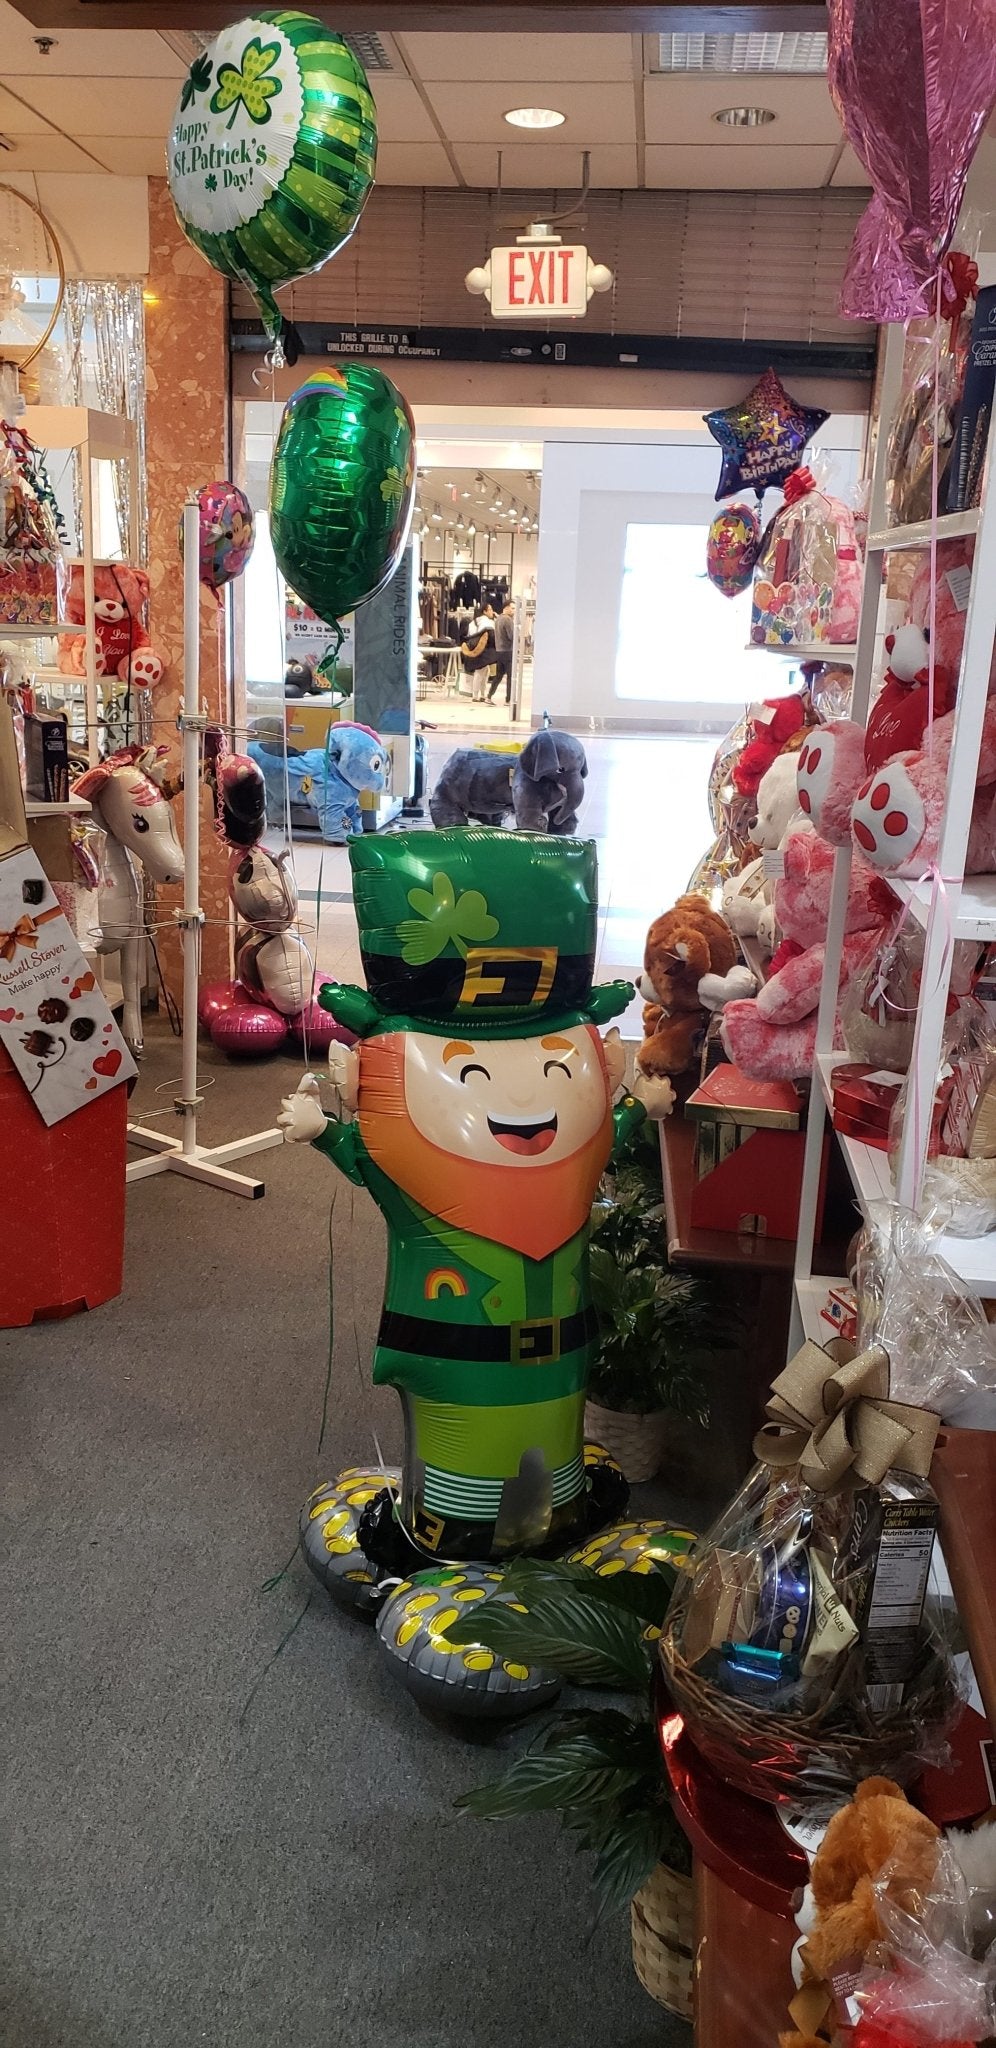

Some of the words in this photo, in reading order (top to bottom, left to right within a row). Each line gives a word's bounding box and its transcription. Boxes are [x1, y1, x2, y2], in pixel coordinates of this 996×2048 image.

[175, 121, 211, 145] Happy
[223, 167, 254, 192] Day!
[508, 250, 574, 304] EXIT
[327, 342, 365, 352] UNLOCKED
[367, 345, 395, 353] DURING
[398, 346, 441, 356] OCCUPANCY
[340, 332, 358, 341] THIS
[388, 334, 399, 343] TO
[394, 558, 407, 612] NIMAL
[110, 629, 130, 640] Lov
[293, 623, 308, 632] $10
[324, 626, 351, 634] MINTES
[392, 615, 406, 656] RIDES
[103, 644, 124, 655] You
[873, 711, 901, 740] Love
[31, 944, 66, 968] Stover
[8, 978, 33, 995] Make
[919, 1549, 929, 1557] 50
[831, 1610, 846, 1633] Nuts
